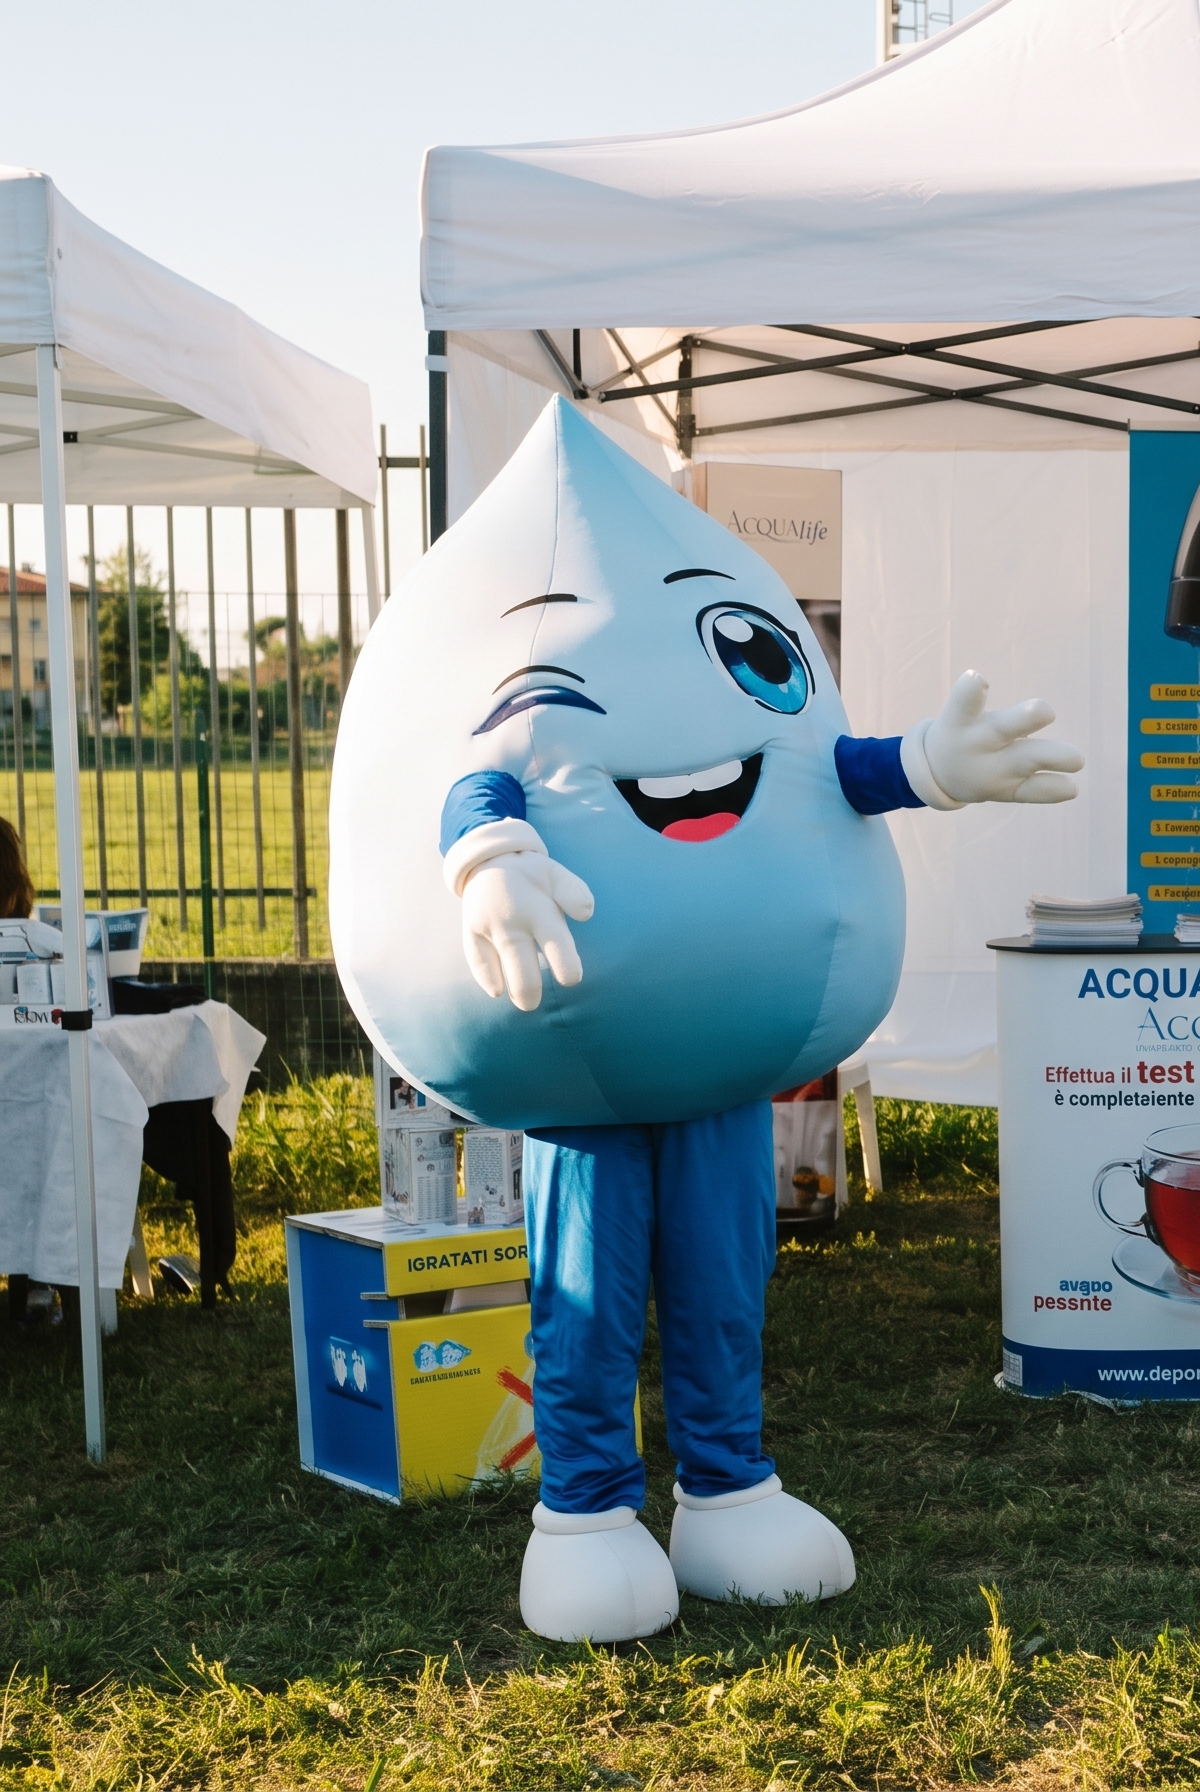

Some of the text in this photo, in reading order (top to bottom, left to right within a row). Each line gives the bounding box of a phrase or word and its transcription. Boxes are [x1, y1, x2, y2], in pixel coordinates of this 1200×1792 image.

[727, 510, 828, 545] ACQUAlife
[1045, 1066, 1115, 1084] Effettua
[1122, 1067, 1131, 1083] il
[1137, 1061, 1195, 1084] test
[1054, 1089, 1064, 1106] è
[408, 1250, 488, 1272] IGRATATI
[1034, 1295, 1112, 1312] pessnte
